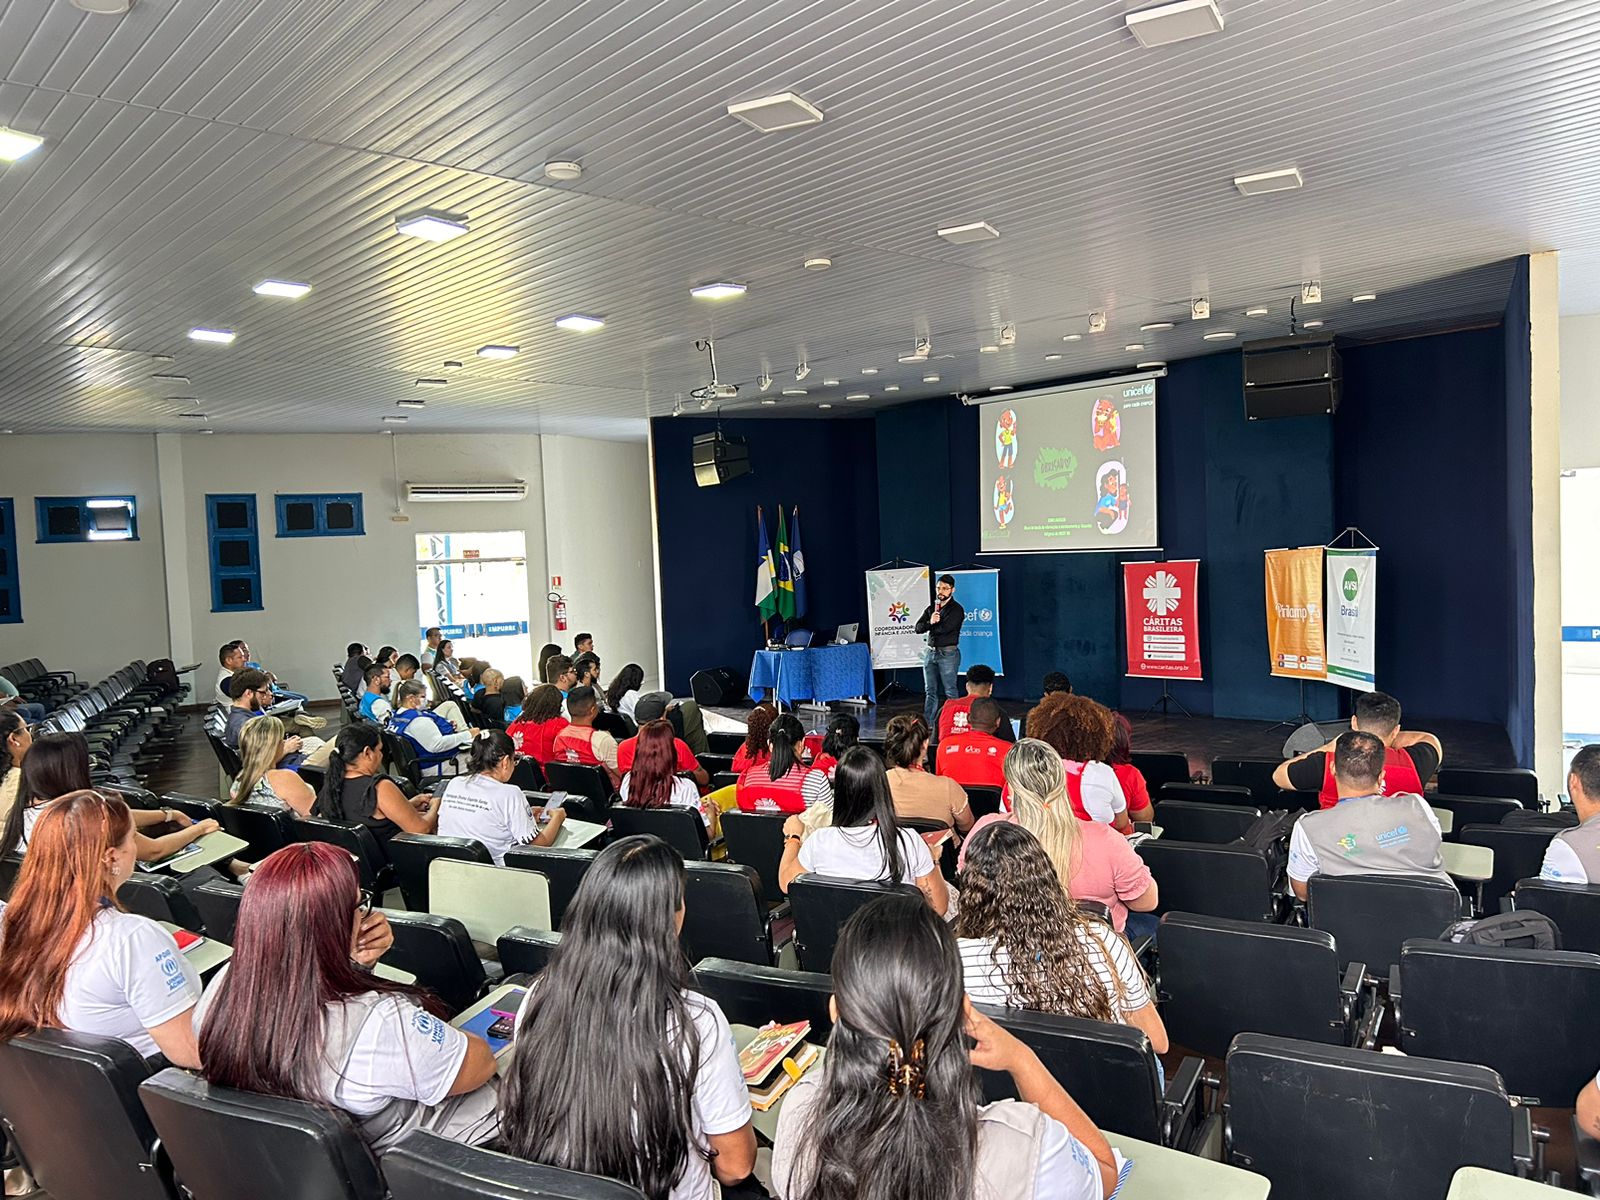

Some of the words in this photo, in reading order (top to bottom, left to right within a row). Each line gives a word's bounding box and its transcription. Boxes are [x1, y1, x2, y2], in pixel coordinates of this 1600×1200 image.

[1123, 384, 1145, 397] unicef
[1344, 580, 1359, 591] AVSI
[1341, 604, 1359, 618] Brasil
[1143, 615, 1183, 626] CÁRITAS
[1375, 828, 1398, 841] unicef
